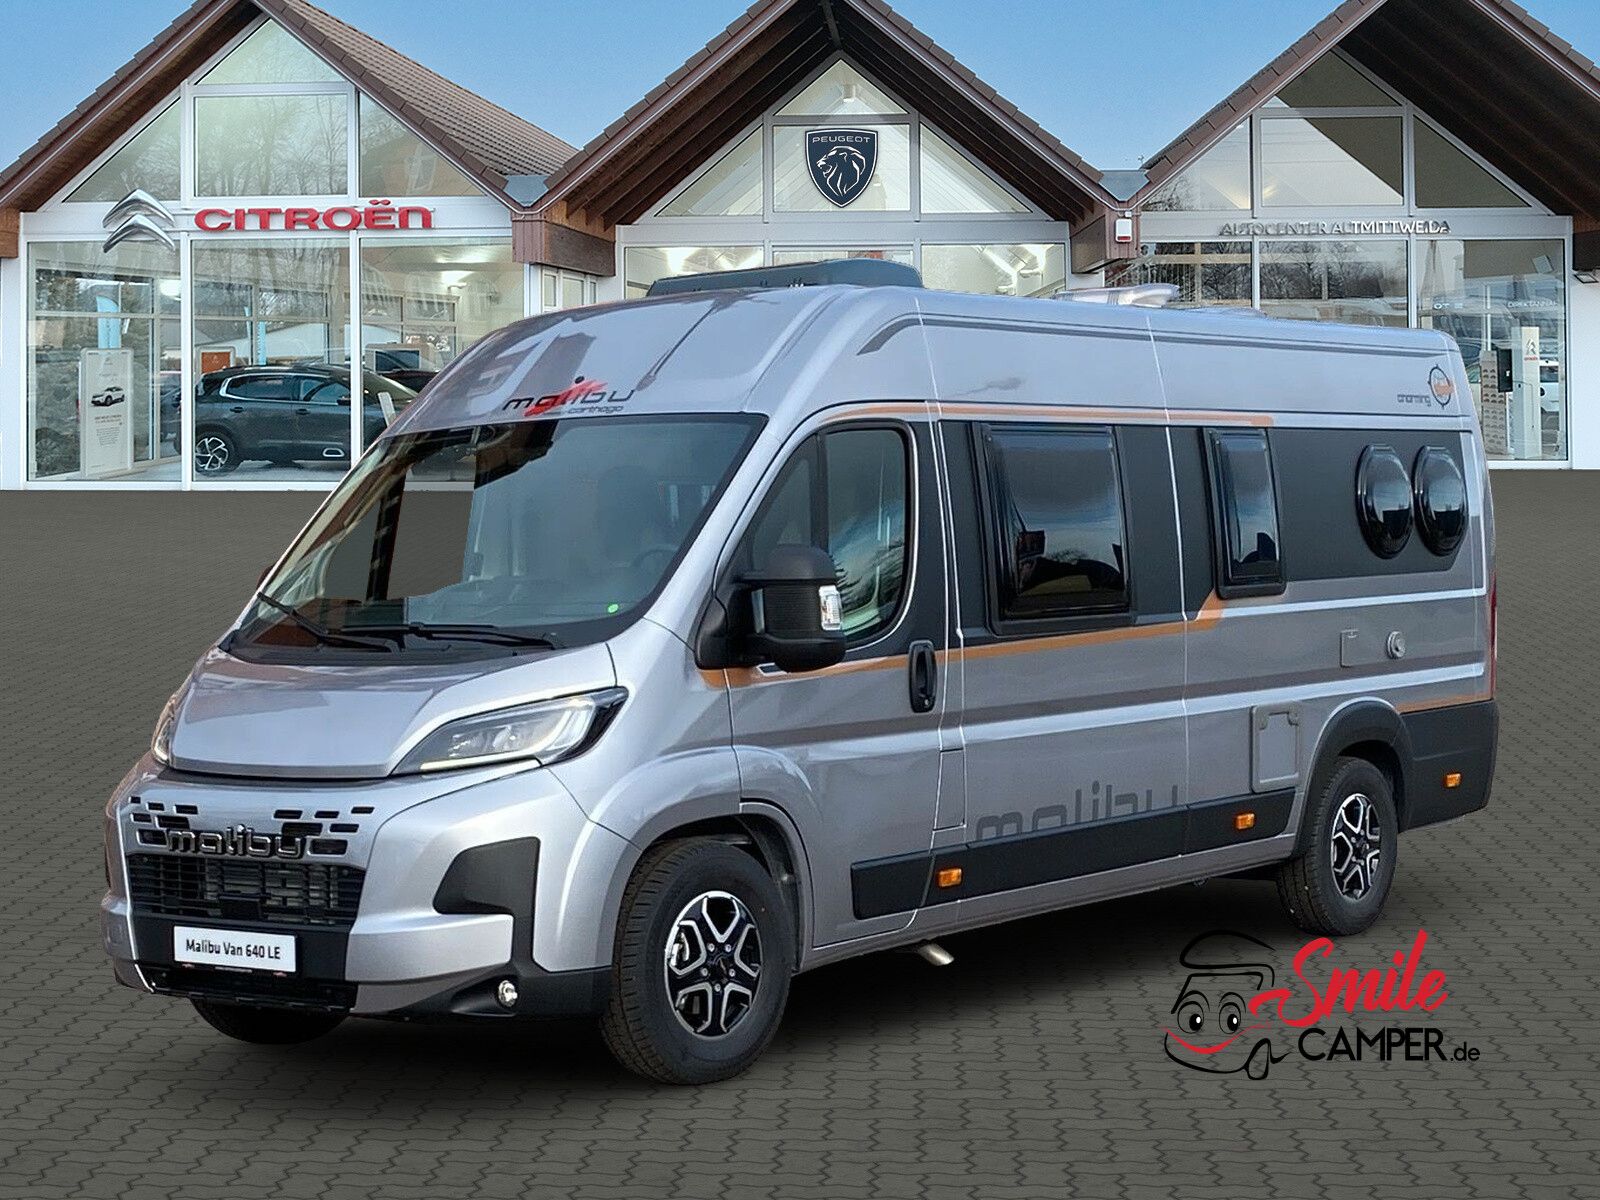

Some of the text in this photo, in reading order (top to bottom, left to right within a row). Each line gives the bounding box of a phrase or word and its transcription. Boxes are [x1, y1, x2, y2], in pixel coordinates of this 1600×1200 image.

[812, 135, 871, 143] PEUGEOT
[1219, 221, 1329, 236] AUTOCENTER
[502, 376, 636, 411] malibu
[167, 823, 305, 860] malibu
[185, 939, 281, 960] Malibu Van 640 LE
